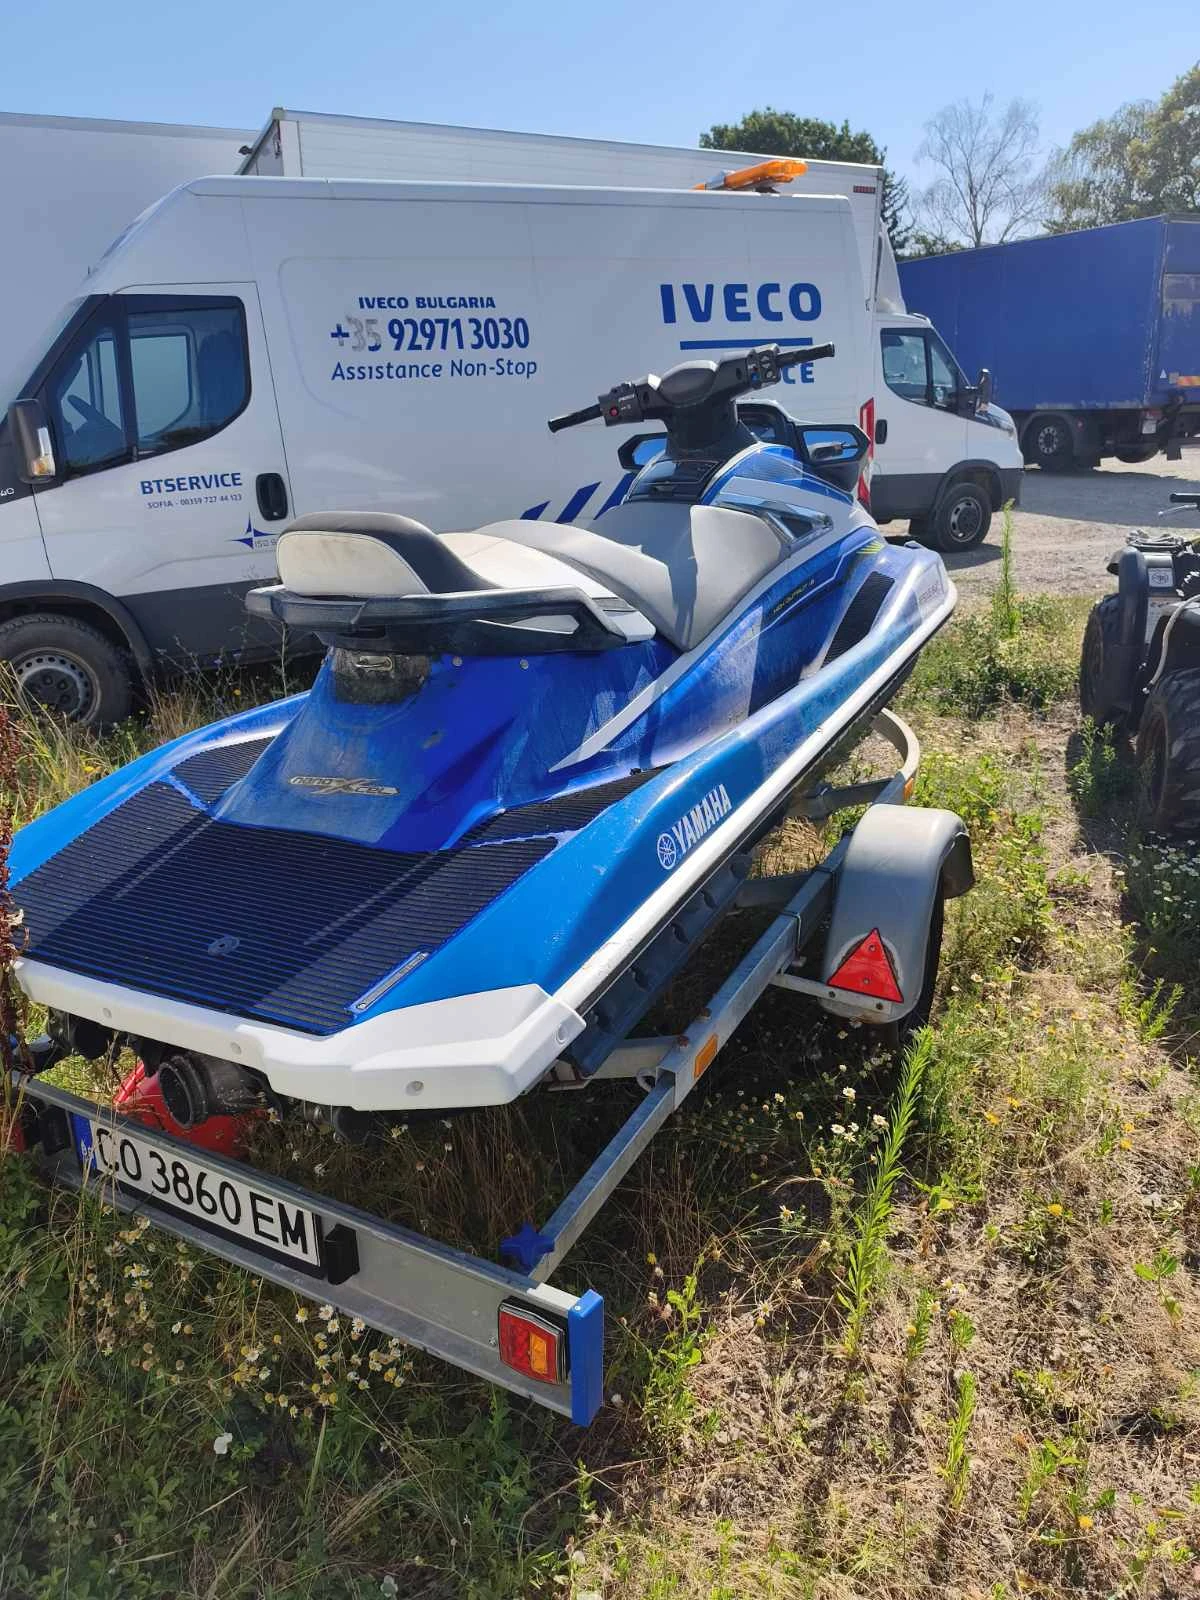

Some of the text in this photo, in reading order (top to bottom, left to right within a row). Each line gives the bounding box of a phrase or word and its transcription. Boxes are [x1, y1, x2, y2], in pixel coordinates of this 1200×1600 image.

[358, 296, 496, 309] IVECO BULGARIA
[660, 282, 822, 324] IVECO
[331, 358, 537, 381] Assistance Non-Stop
[140, 472, 243, 495] BTSERVICE
[147, 500, 174, 509] SOFIA
[671, 783, 732, 854] YAMAHA
[149, 1150, 242, 1226] 3860
[249, 1190, 309, 1255] EM
